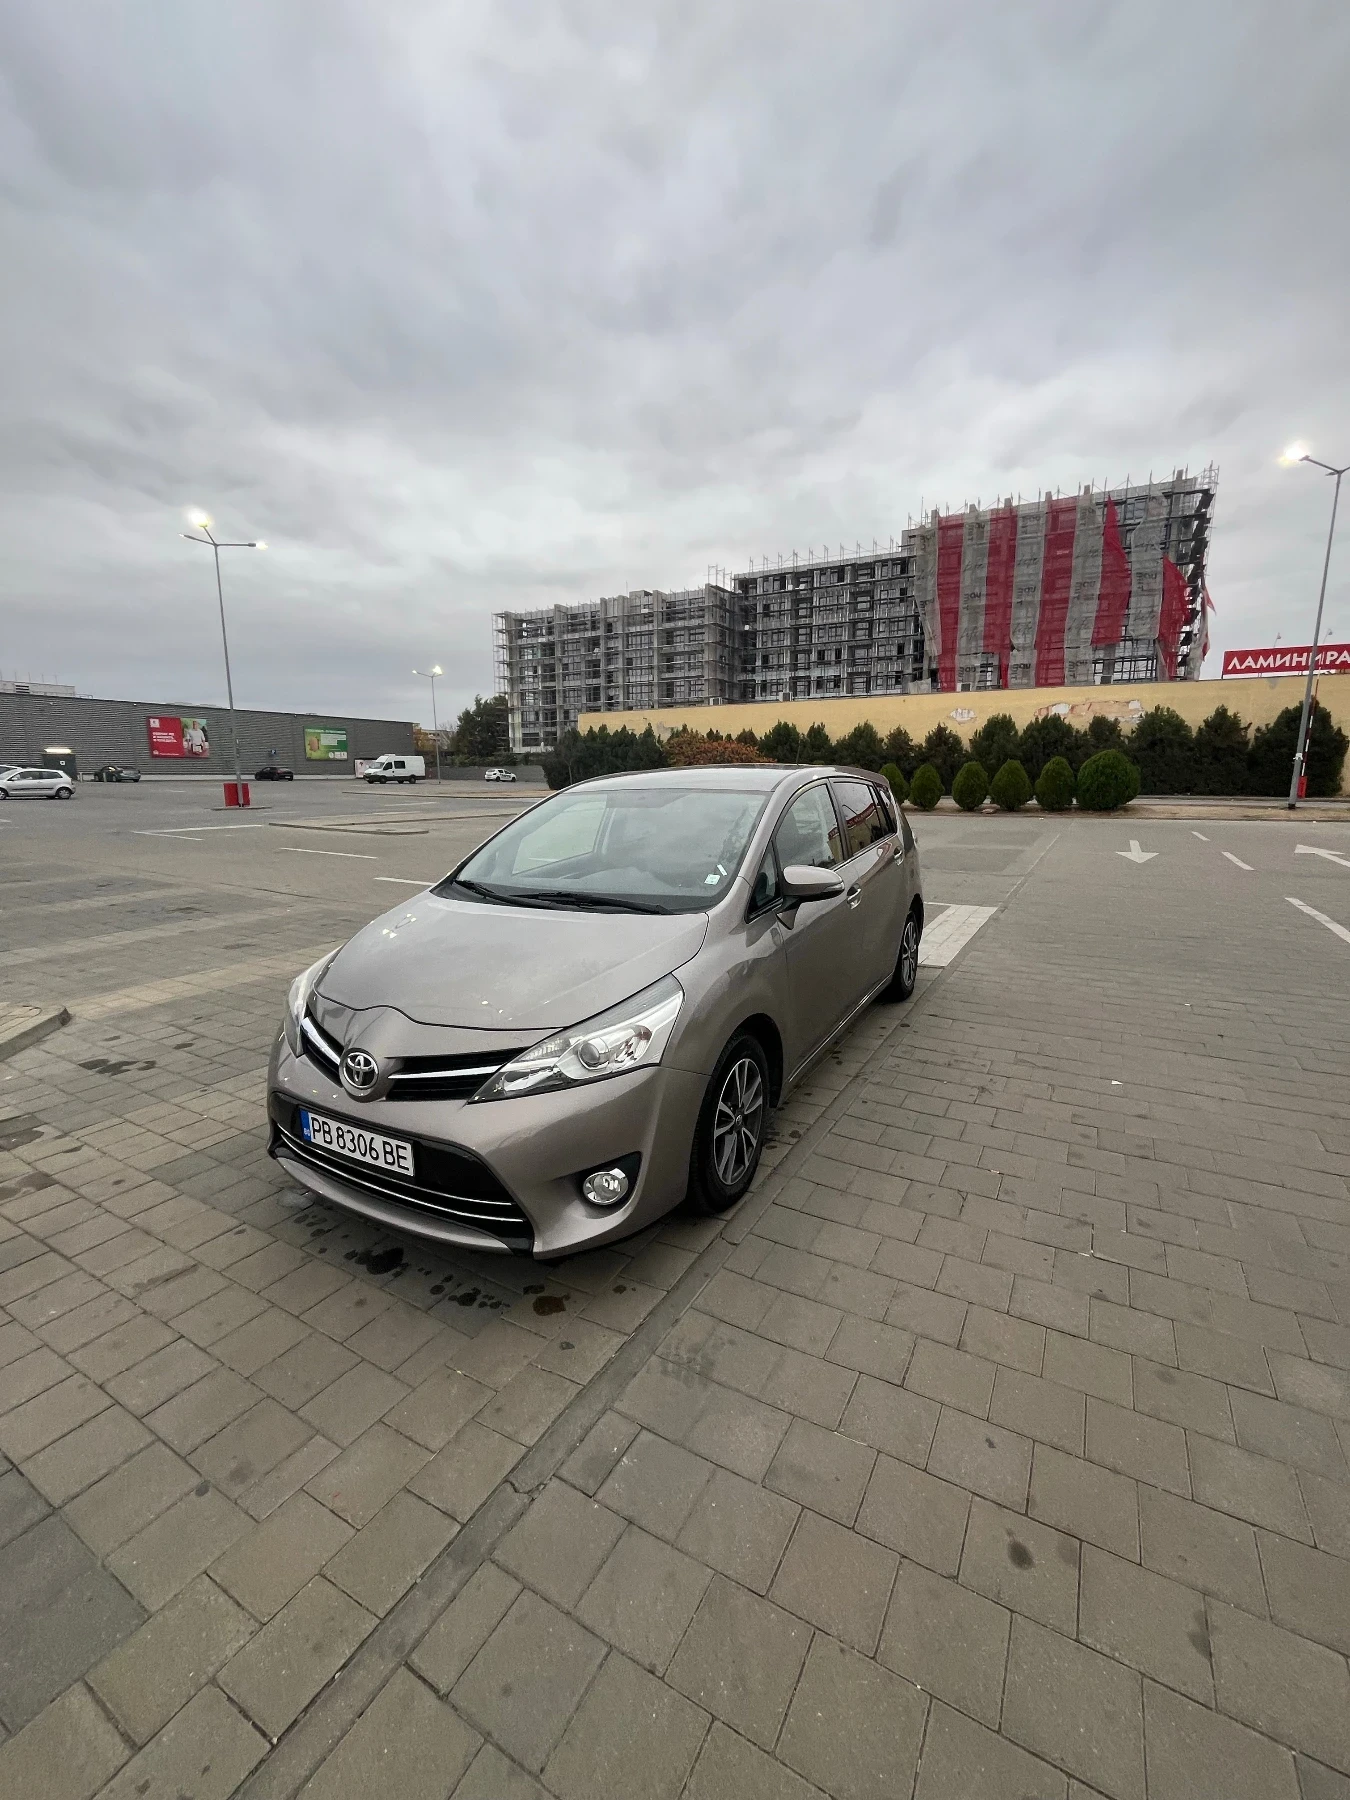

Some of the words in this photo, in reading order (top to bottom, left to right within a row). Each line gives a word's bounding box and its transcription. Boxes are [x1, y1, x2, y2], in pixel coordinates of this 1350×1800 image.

[311, 1116, 333, 1145] PB
[336, 1126, 380, 1161] 8306
[382, 1140, 410, 1171] BE
